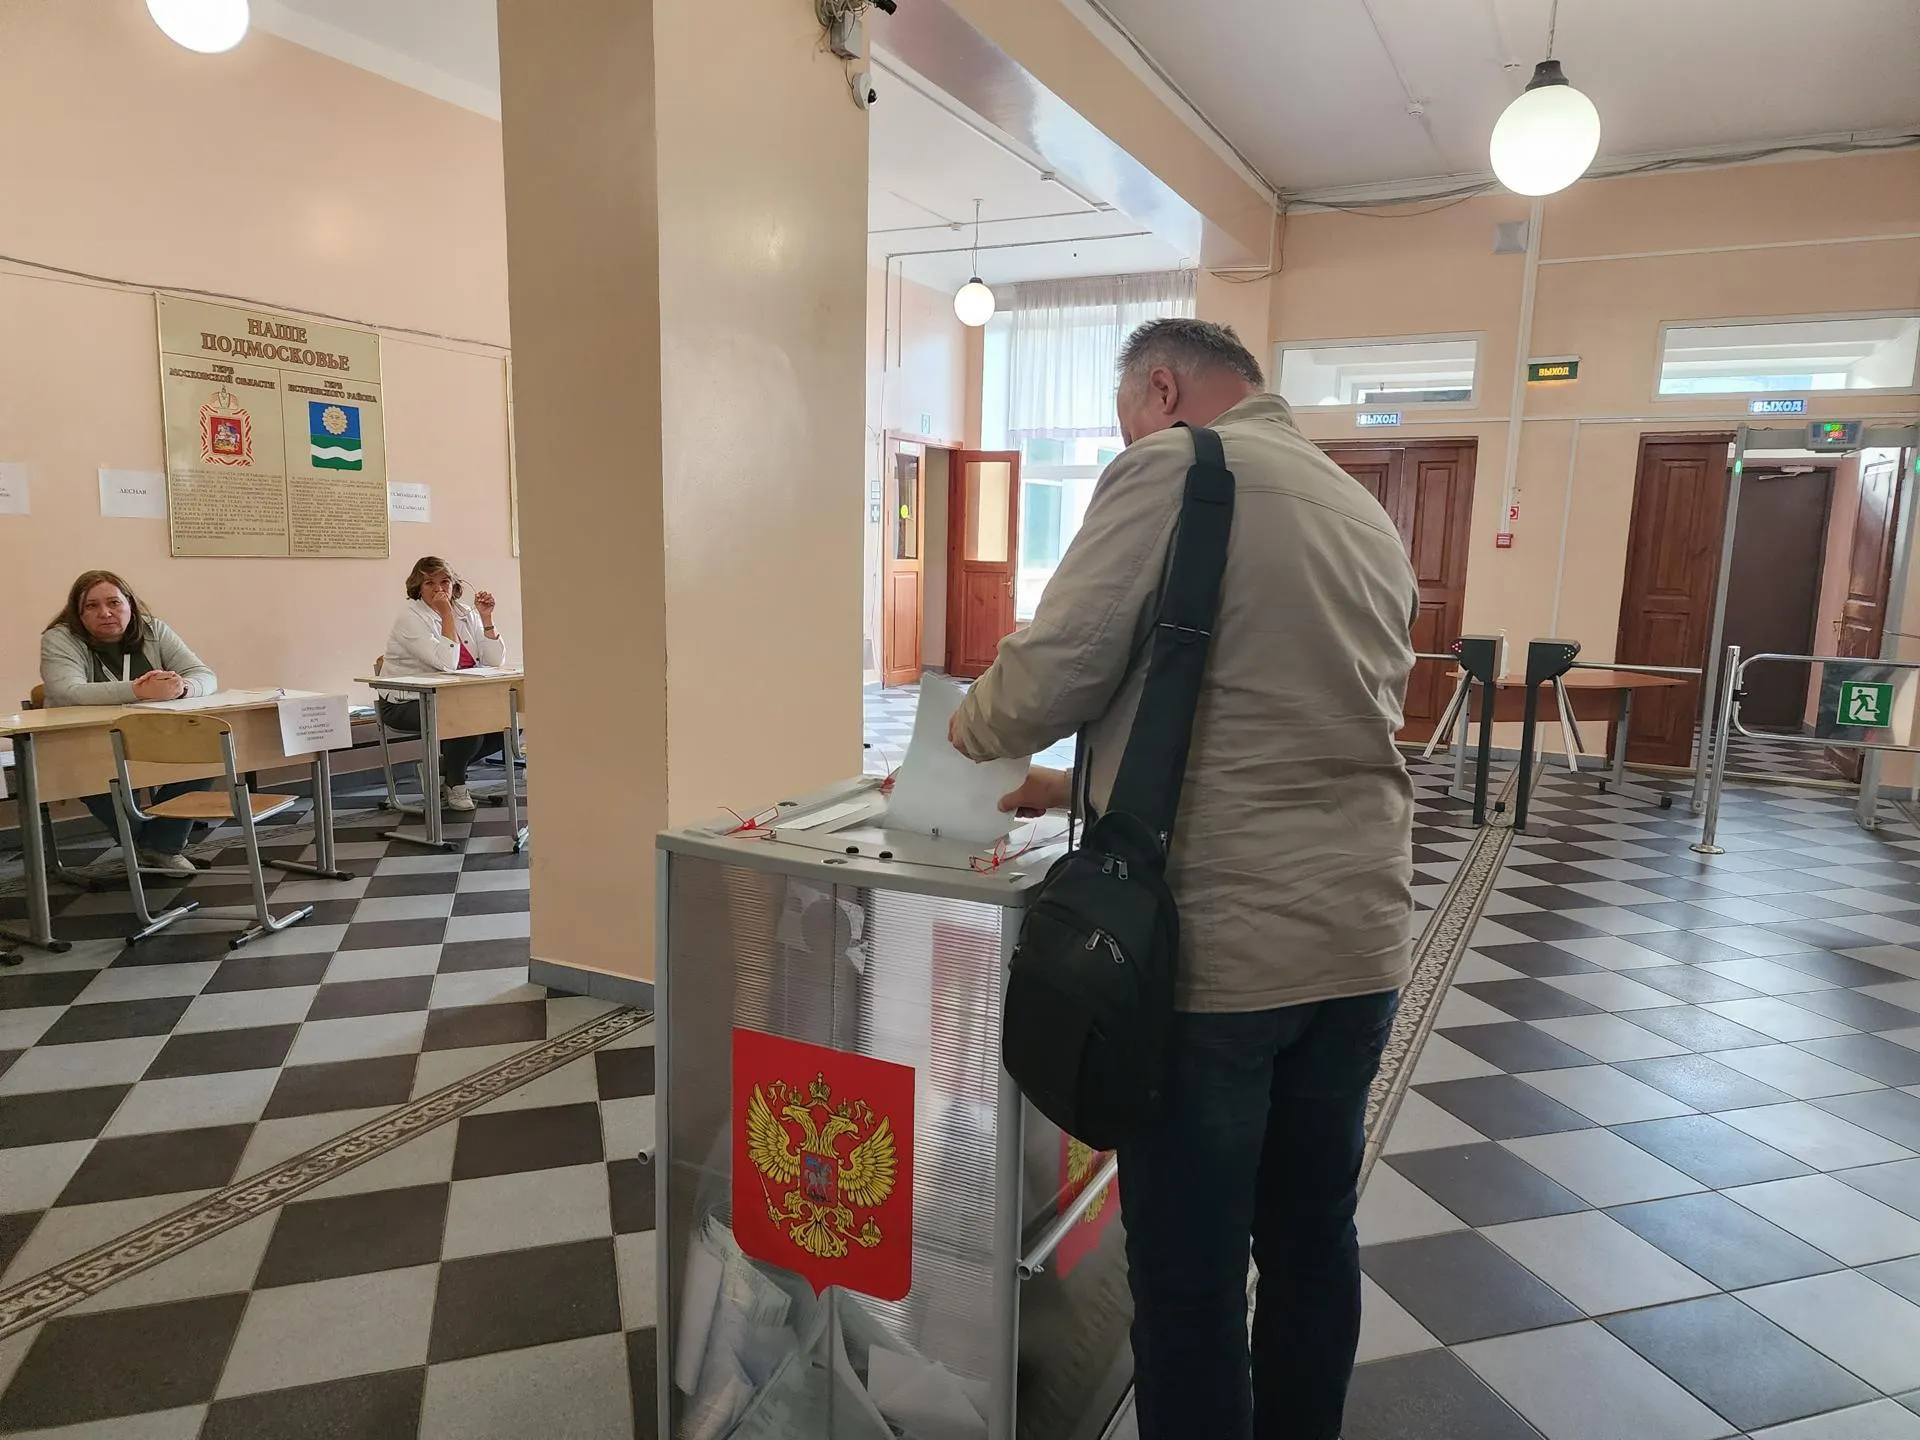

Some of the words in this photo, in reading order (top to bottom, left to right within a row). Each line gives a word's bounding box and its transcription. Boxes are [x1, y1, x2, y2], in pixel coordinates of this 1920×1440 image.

[247, 318, 308, 344] НАШЕ
[201, 332, 350, 371] ПОДМОСКОВЬЕ
[212, 364, 235, 375] ГЕРБ
[1538, 366, 1569, 377] ВЫХОД
[169, 367, 233, 384] МОСКОВСКОЙ
[235, 376, 276, 390] ОБЛАСТИ
[324, 380, 343, 390] ГЕРБ
[288, 383, 345, 399] ИСТРИНСКОГО
[347, 391, 377, 403] РАЙОНА
[1753, 400, 1803, 413] ВЫХОД
[119, 487, 147, 496] ЛЕСНАЯ
